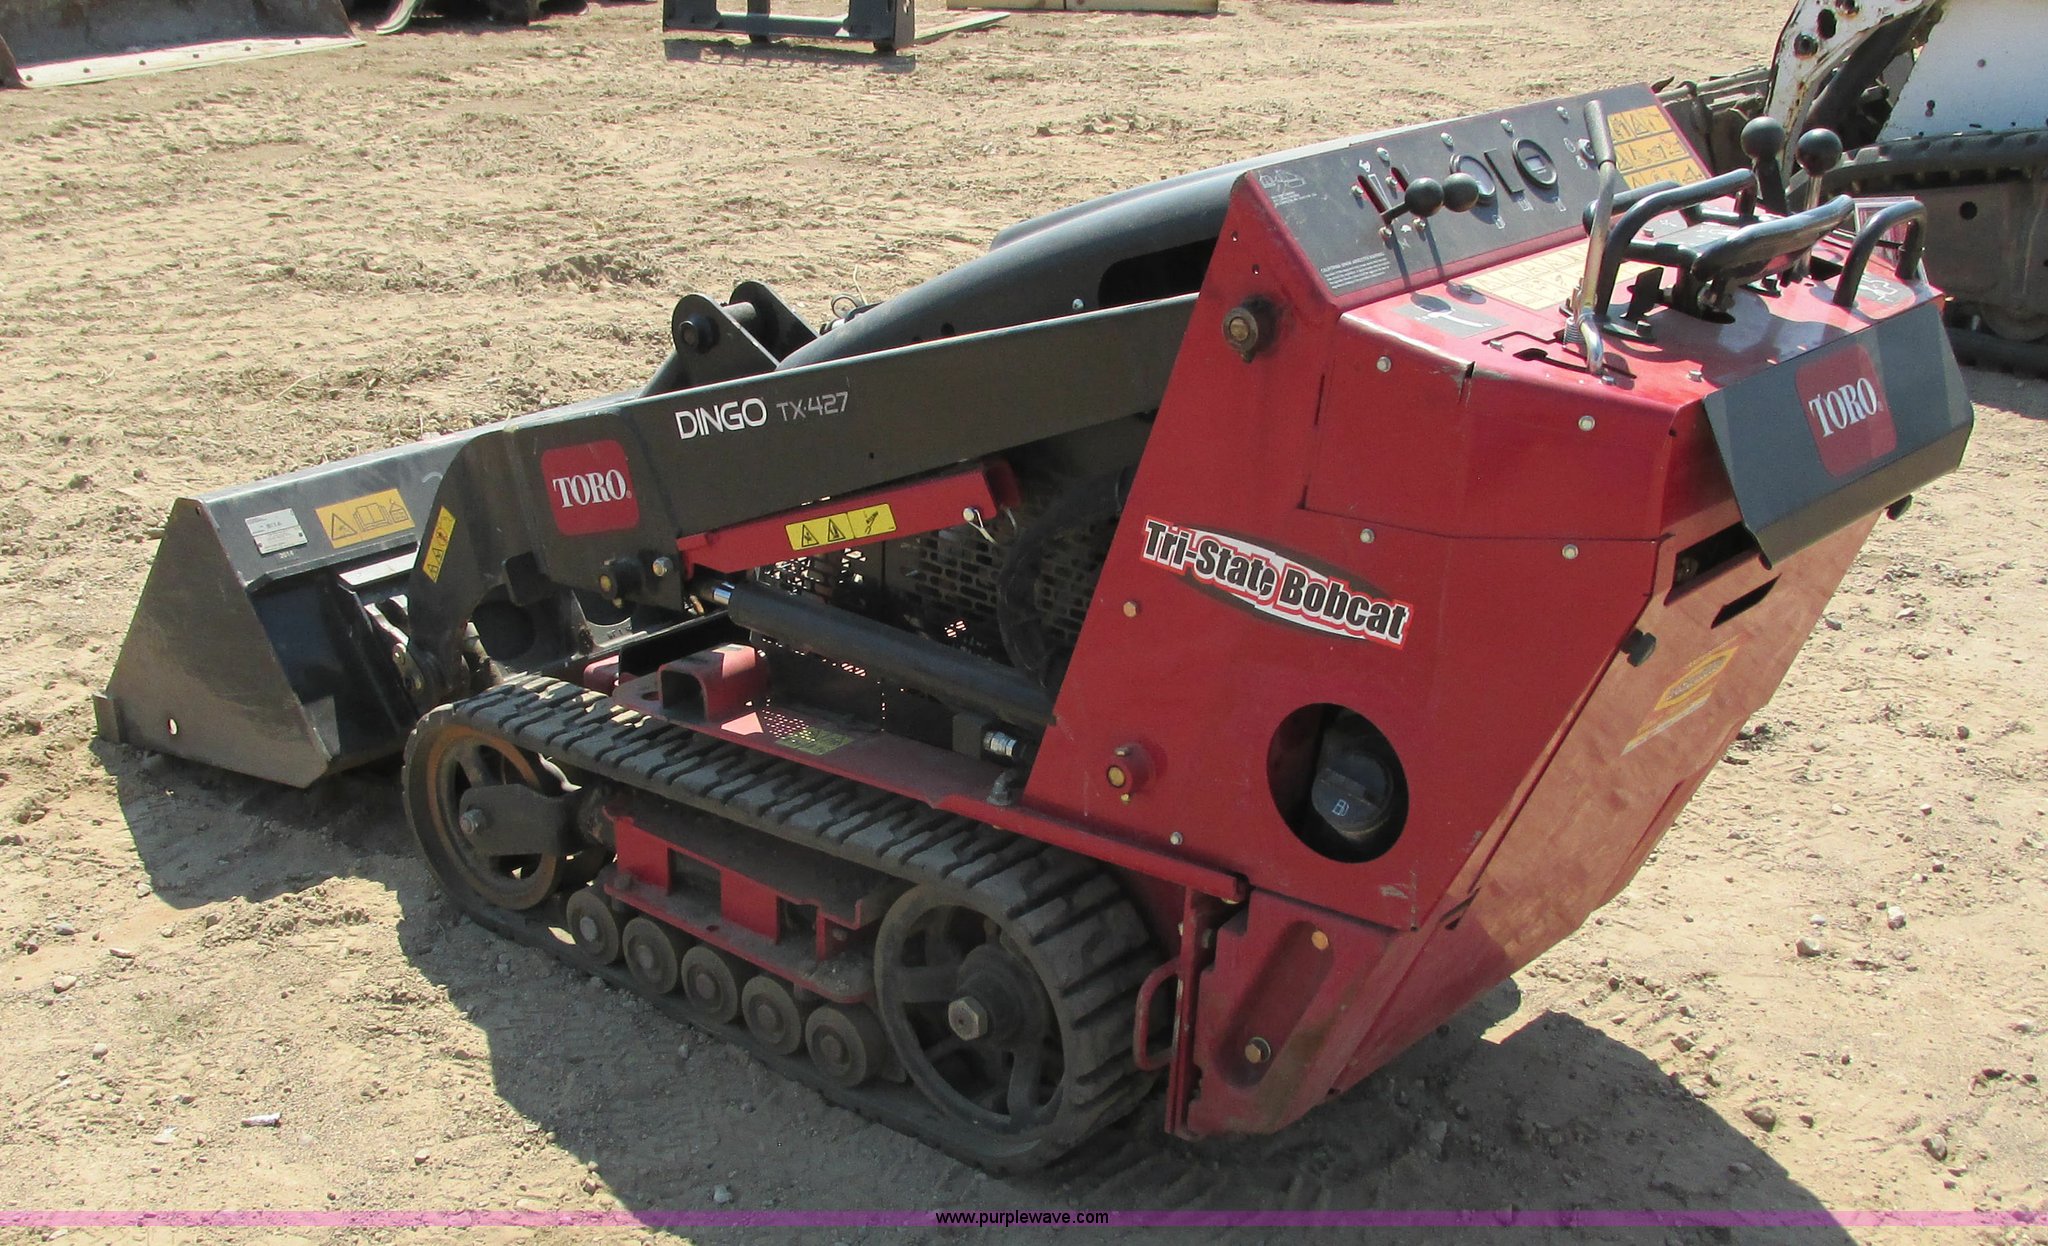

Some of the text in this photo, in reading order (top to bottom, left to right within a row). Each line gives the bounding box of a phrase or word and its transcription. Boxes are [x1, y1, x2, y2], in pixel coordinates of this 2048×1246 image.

[674, 396, 768, 440] DINGO
[1808, 377, 1878, 438] TORO
[552, 468, 629, 509] TORO
[1143, 520, 1410, 642] Tri-State Bobcat
